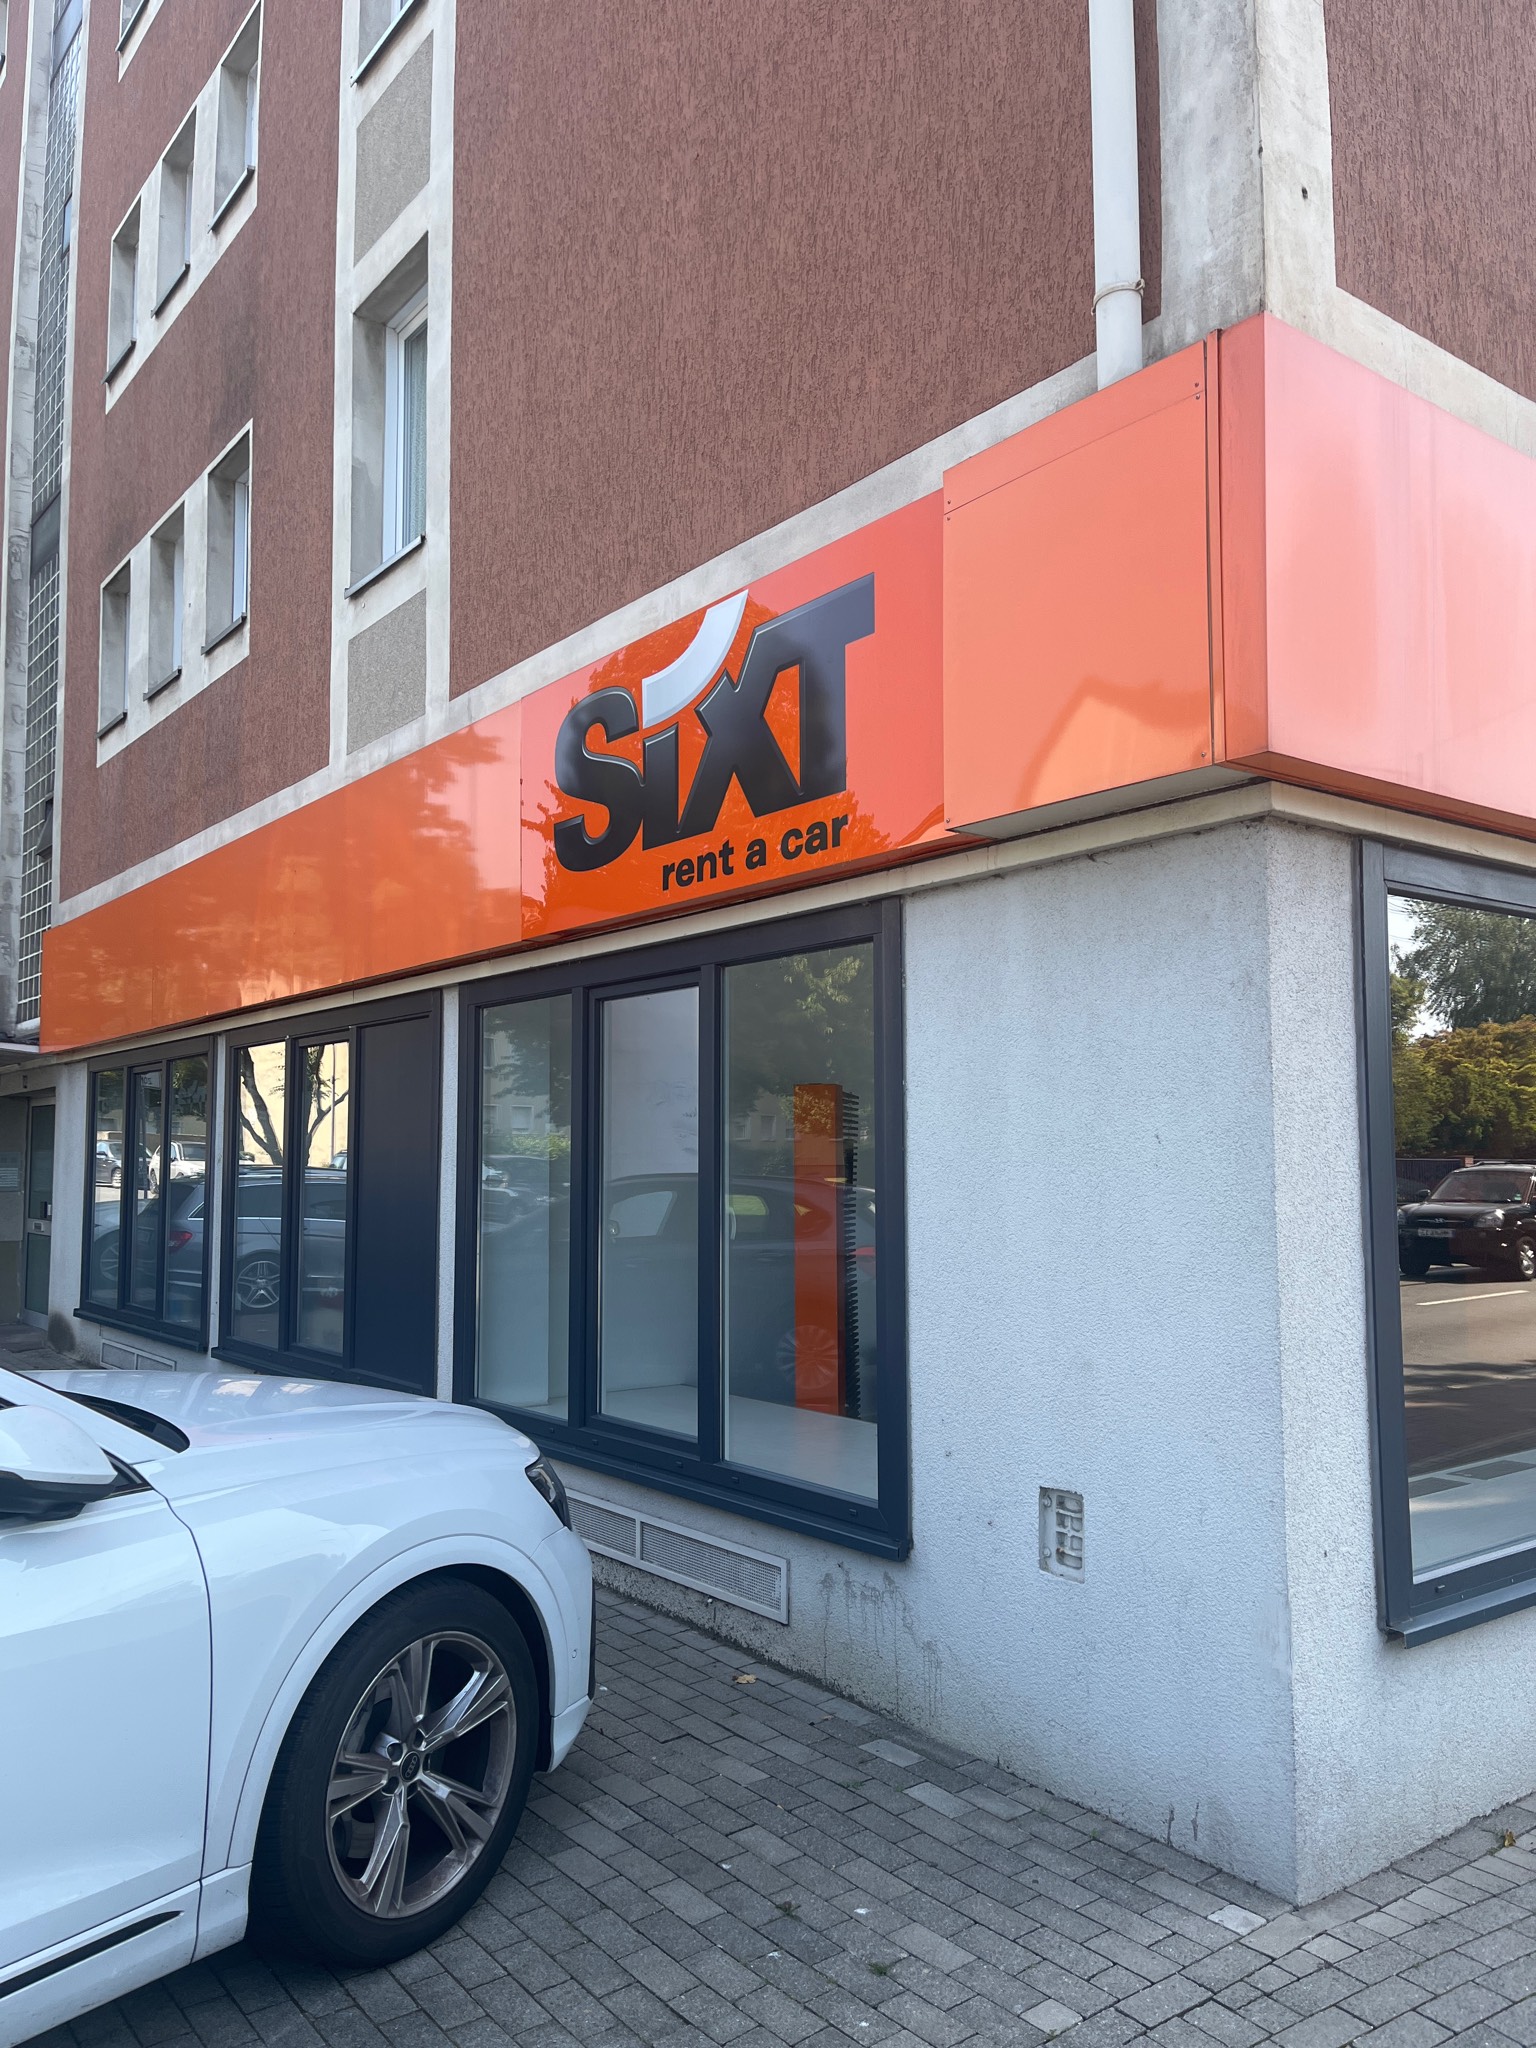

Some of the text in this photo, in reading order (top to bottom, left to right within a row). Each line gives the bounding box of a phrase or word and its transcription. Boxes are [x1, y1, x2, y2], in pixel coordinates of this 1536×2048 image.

[662, 814, 848, 891] rent a car
